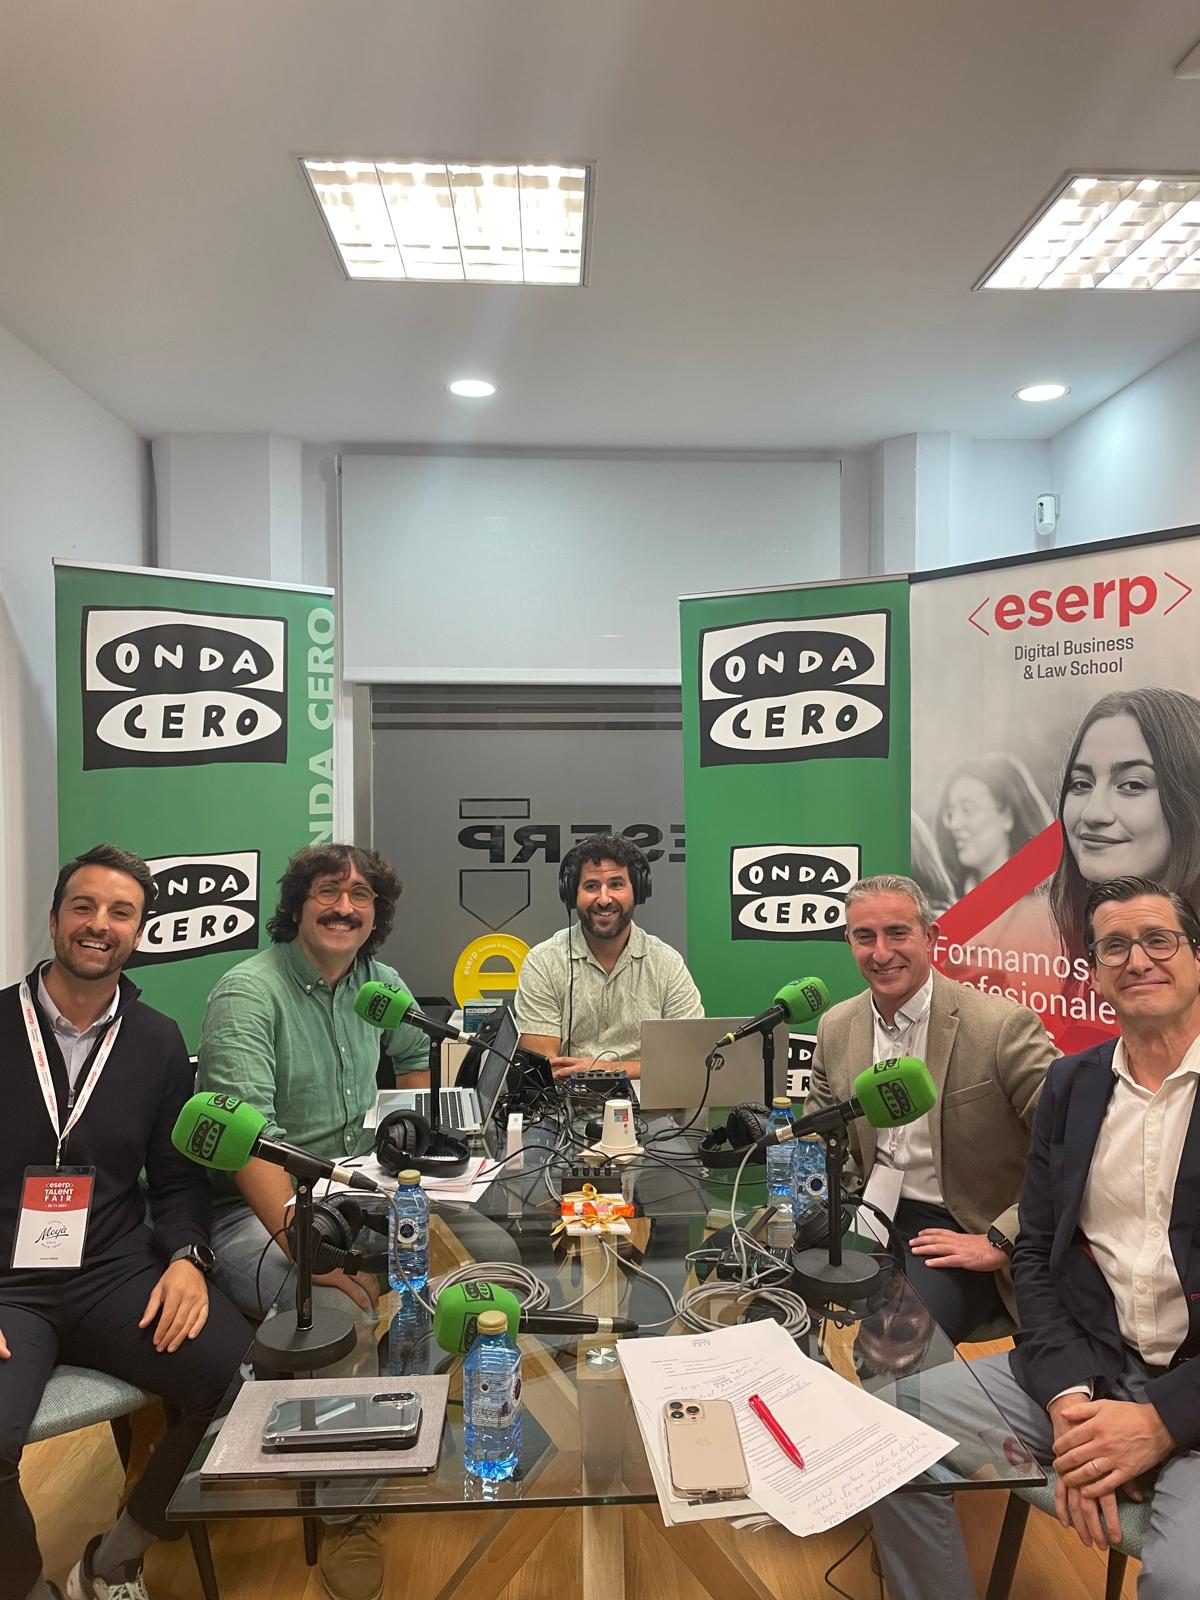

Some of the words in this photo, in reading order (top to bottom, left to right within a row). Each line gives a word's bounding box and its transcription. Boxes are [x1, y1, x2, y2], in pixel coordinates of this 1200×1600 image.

[994, 575, 1158, 631] eserp
[115, 642, 258, 675] ONDA
[725, 646, 857, 683] ONDA
[1014, 641, 1059, 662] Digital
[1064, 637, 1134, 656] Business
[307, 607, 335, 730] CERO
[1023, 665, 1034, 680] &
[1037, 664, 1067, 679] Law
[1070, 657, 1123, 677] School
[123, 703, 259, 739] CERO
[732, 703, 858, 740] CERO
[308, 747, 334, 847] NDA
[748, 865, 840, 885] ONDA
[147, 914, 239, 945] CERO
[754, 902, 840, 924] CERO
[933, 935, 1090, 981] Formamos
[202, 1127, 219, 1154] CERO
